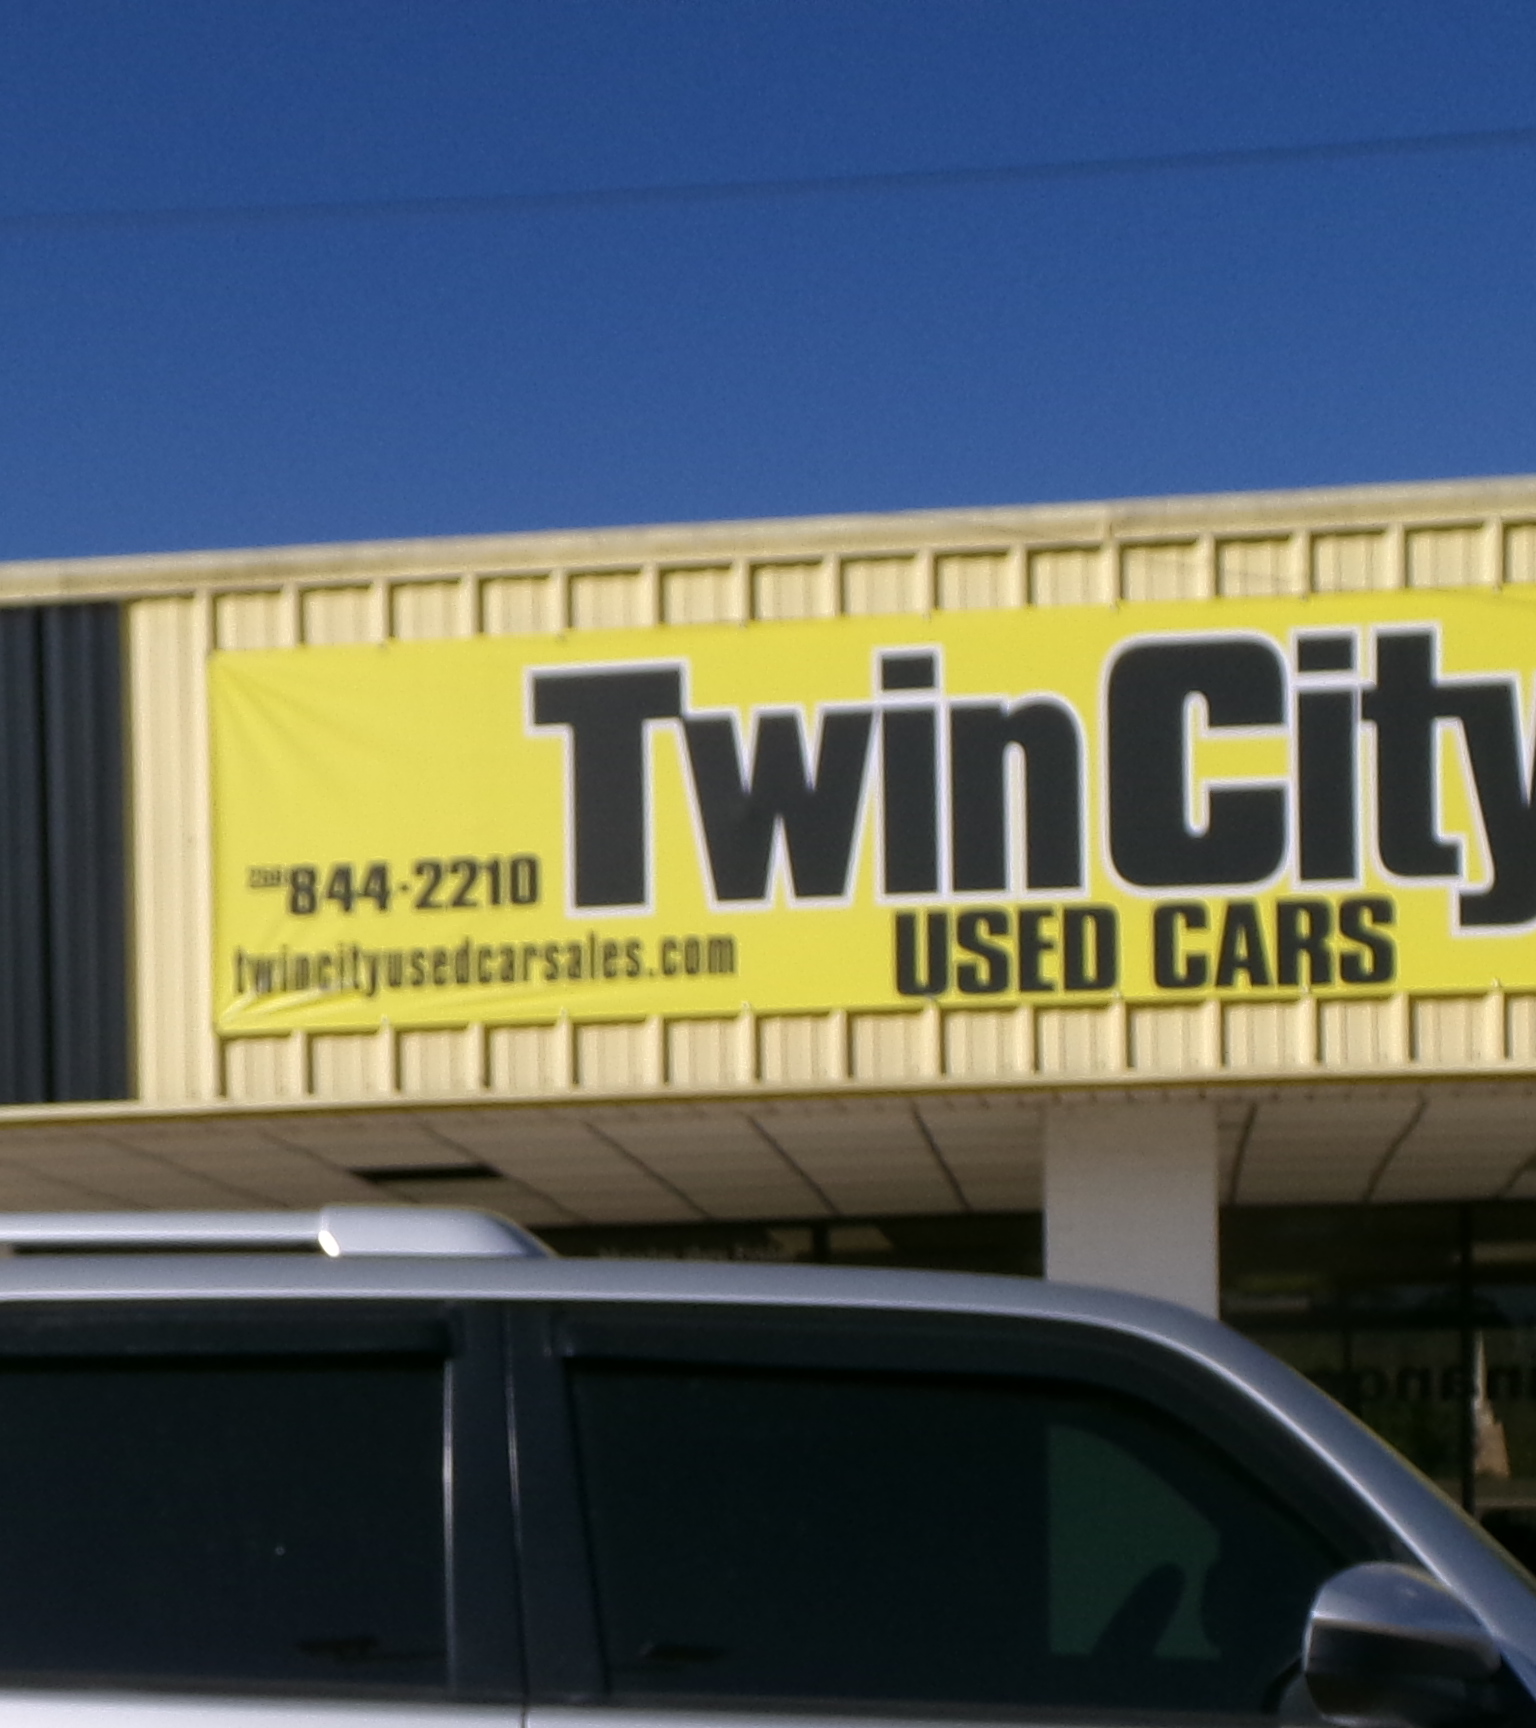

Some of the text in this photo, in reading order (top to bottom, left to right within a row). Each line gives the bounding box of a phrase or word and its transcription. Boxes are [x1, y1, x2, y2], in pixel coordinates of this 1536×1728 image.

[233, 933, 738, 997] twincityusedcarsales.com
[895, 897, 1397, 997] USED CARS
